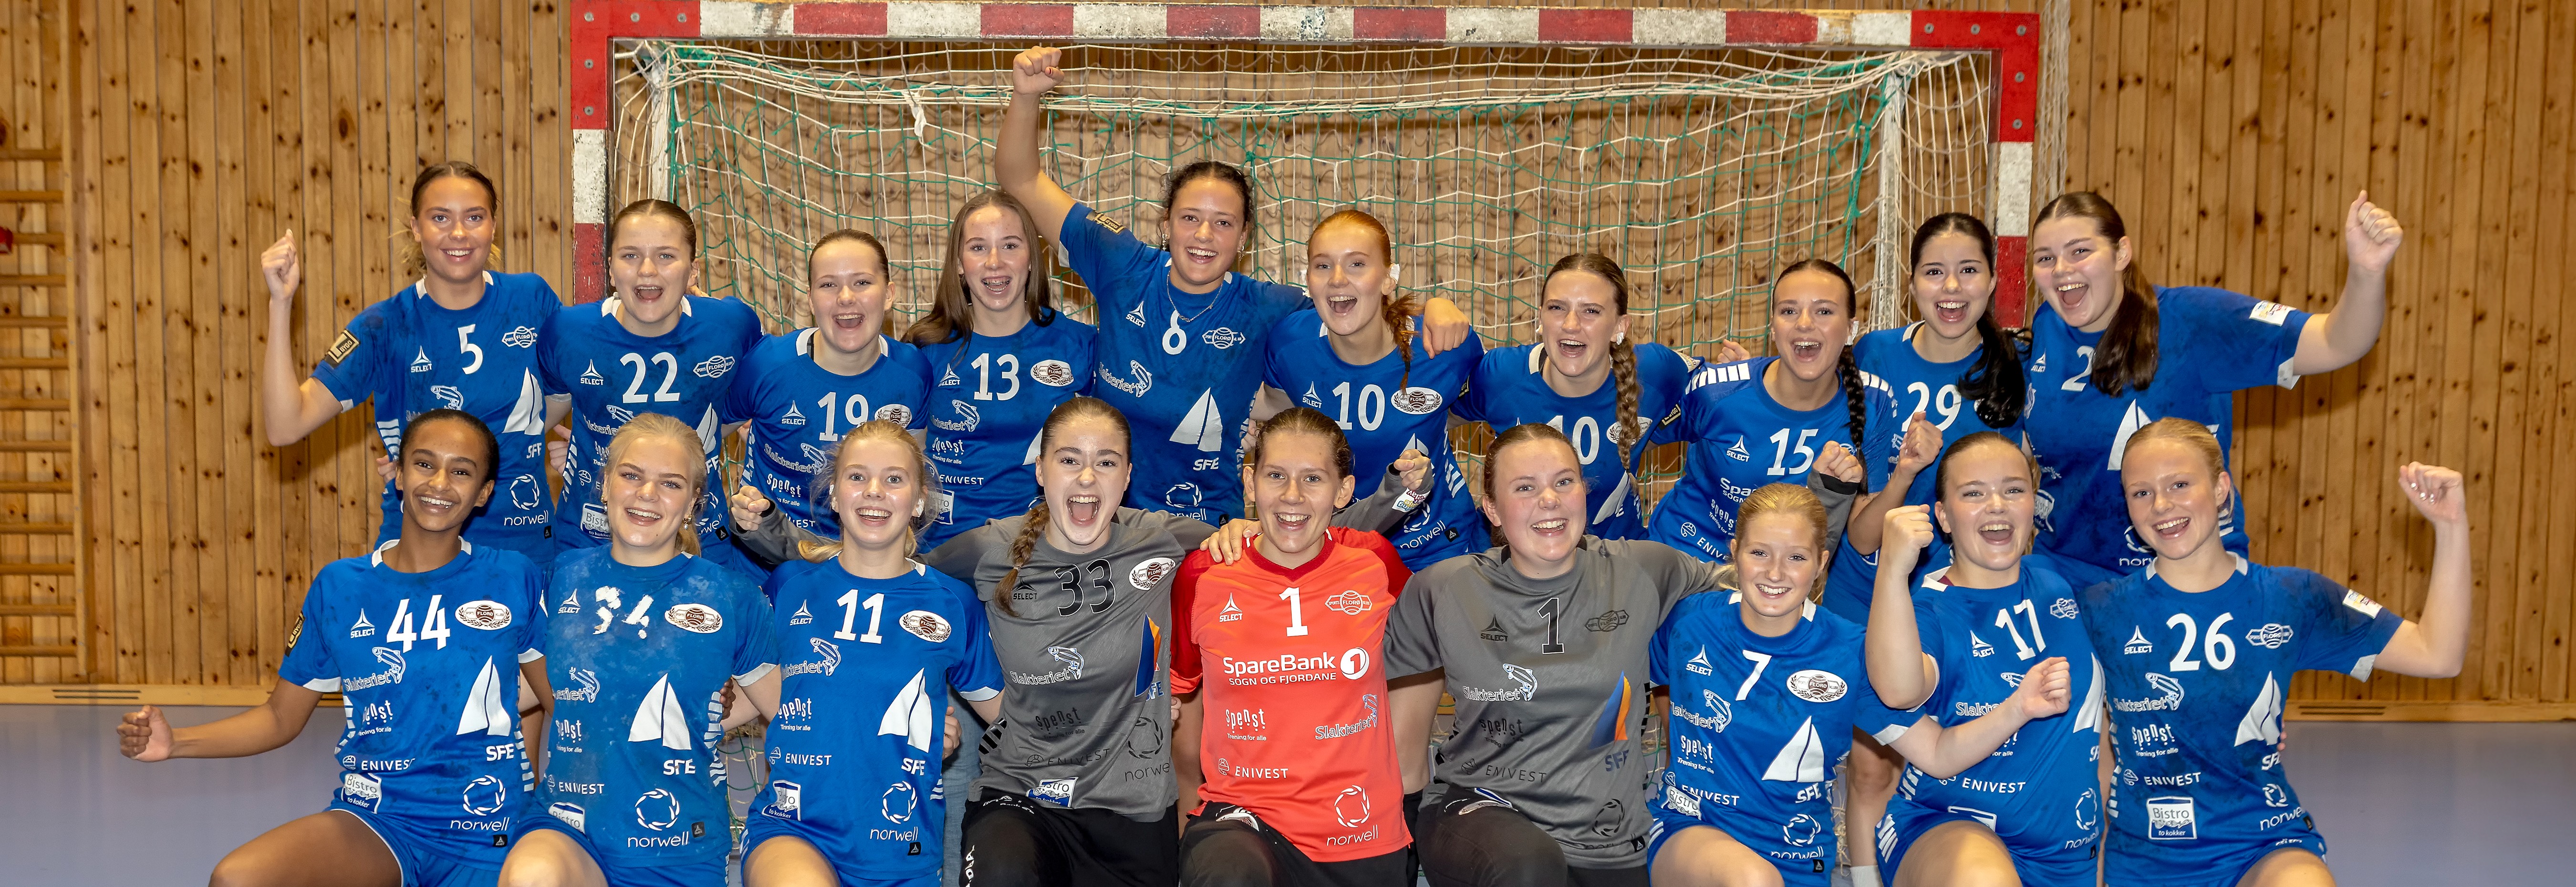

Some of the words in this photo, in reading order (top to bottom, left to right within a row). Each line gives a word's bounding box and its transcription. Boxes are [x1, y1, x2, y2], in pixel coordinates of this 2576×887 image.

[1126, 313, 1146, 328] SELECT
[1162, 309, 1187, 355] 6
[457, 324, 483, 375] 5
[411, 363, 432, 373] SELECT
[620, 352, 681, 403] 22
[971, 353, 1020, 401] 13
[1302, 396, 1322, 409] SELECT
[1332, 382, 1384, 431] 10
[1901, 382, 1962, 432] 29
[818, 392, 869, 442] 19
[764, 443, 812, 473] Slakteriet
[1726, 450, 1750, 462] SELECT
[1767, 428, 1818, 476] 15
[939, 474, 984, 486] ENIVEST
[504, 510, 549, 526] norwell
[586, 512, 609, 526] Bistr
[1400, 520, 1446, 549] norwell
[1054, 559, 1116, 617] 33
[833, 589, 885, 644] 11
[1219, 612, 1243, 623] SELECT
[1278, 587, 1309, 637] 1
[386, 595, 450, 653] 44
[790, 618, 813, 626] SELECT
[921, 621, 936, 629] FLORØ
[1537, 597, 1565, 655] 1
[1995, 599, 2046, 660] 17
[351, 628, 375, 639] SELECT
[1480, 633, 1508, 642] SELECT
[2124, 645, 2153, 655] SELECT
[2166, 612, 2236, 672] 26
[1223, 652, 1337, 677] SpareBank
[1686, 663, 1713, 676] SELECT
[344, 670, 391, 692] Slakteriet
[1010, 668, 1070, 686] Slakteriet
[1229, 677, 1257, 686] SOGN
[1260, 676, 1276, 684] OG
[1279, 672, 1337, 685] FJORDANE
[1735, 650, 1772, 701] 7
[1463, 686, 1521, 702] Slakteriet
[1075, 727, 1085, 735] alle
[1315, 716, 1371, 741] Slakteriet
[1227, 733, 1246, 742] Trening
[486, 743, 515, 762] SFE
[786, 753, 832, 766] ENIVEST
[2156, 748, 2165, 756] for
[361, 758, 415, 771] ENIVEST
[1677, 757, 1698, 770] Trening
[1235, 766, 1288, 779] ENIVEST
[1486, 764, 1547, 784] ENIVEST
[2144, 772, 2201, 786] ENIVEST
[346, 774, 378, 794] Bistro
[559, 782, 605, 794] ENIVEST
[1962, 777, 2026, 794] ENIVEST
[1795, 784, 1822, 804] SFE
[353, 798, 370, 808] kokker
[774, 809, 791, 818] kokker
[2152, 808, 2190, 820] Bistro
[450, 817, 510, 832] norwell
[627, 831, 689, 848] norwell
[870, 827, 919, 842] norwell
[1327, 824, 1379, 846] norwell
